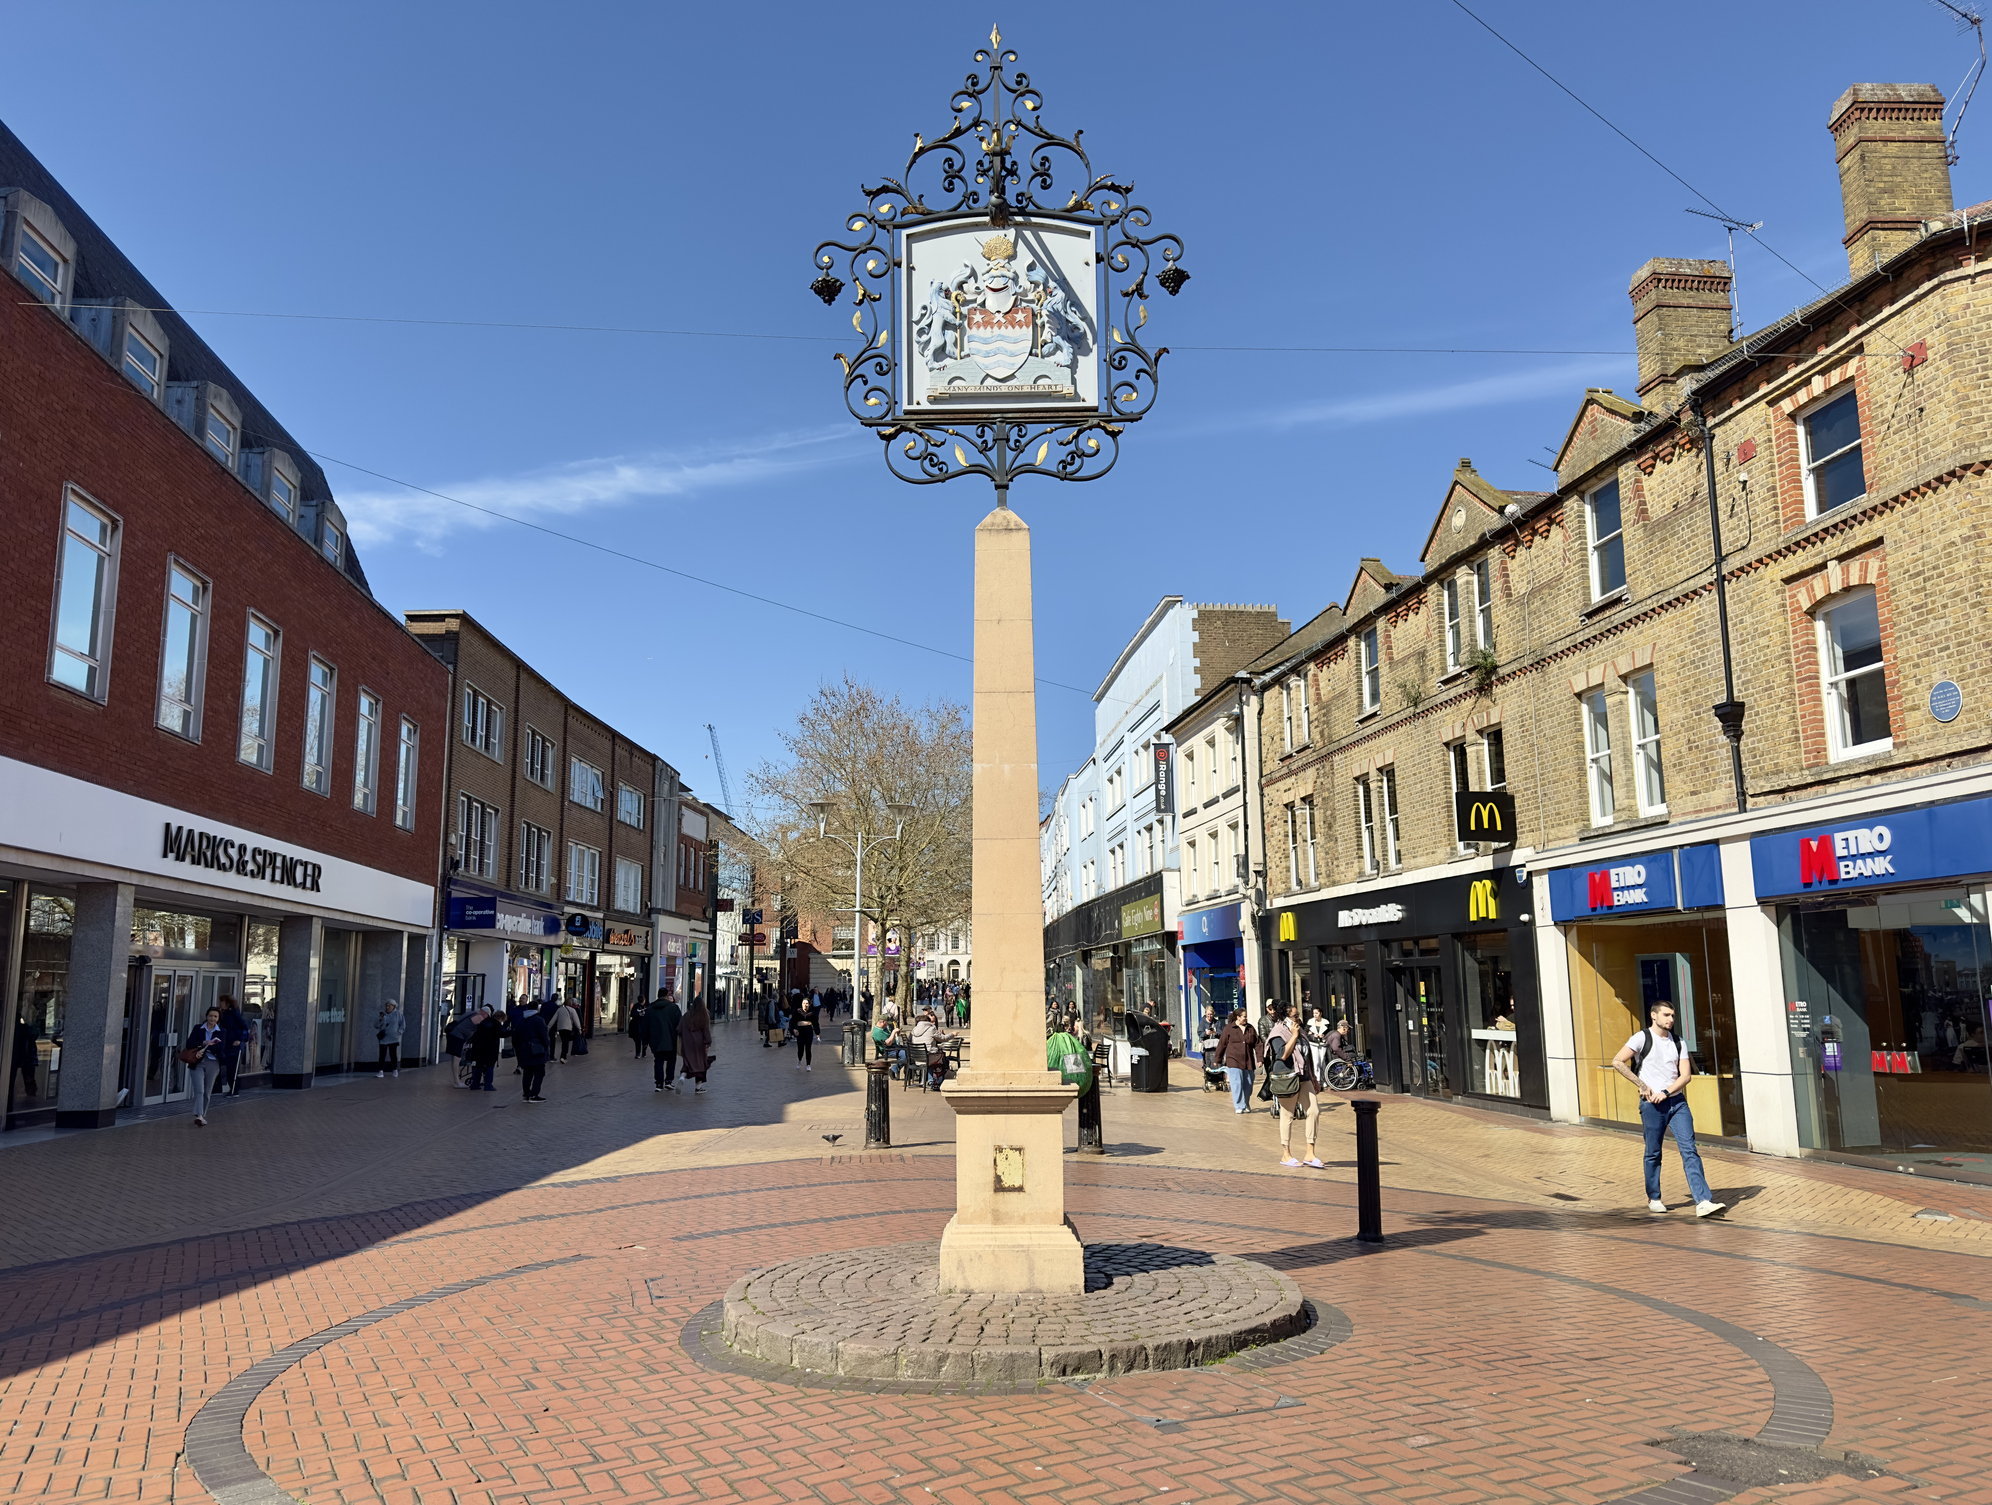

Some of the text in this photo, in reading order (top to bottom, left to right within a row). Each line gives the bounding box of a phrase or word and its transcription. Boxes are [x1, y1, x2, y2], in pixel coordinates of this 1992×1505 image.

[1158, 764, 1167, 797] Range
[1800, 825, 1892, 883] METRO
[1839, 855, 1896, 880] BANK
[1588, 864, 1647, 908] METRO
[1613, 887, 1649, 906] BANK
[1143, 904, 1153, 922] Nine
